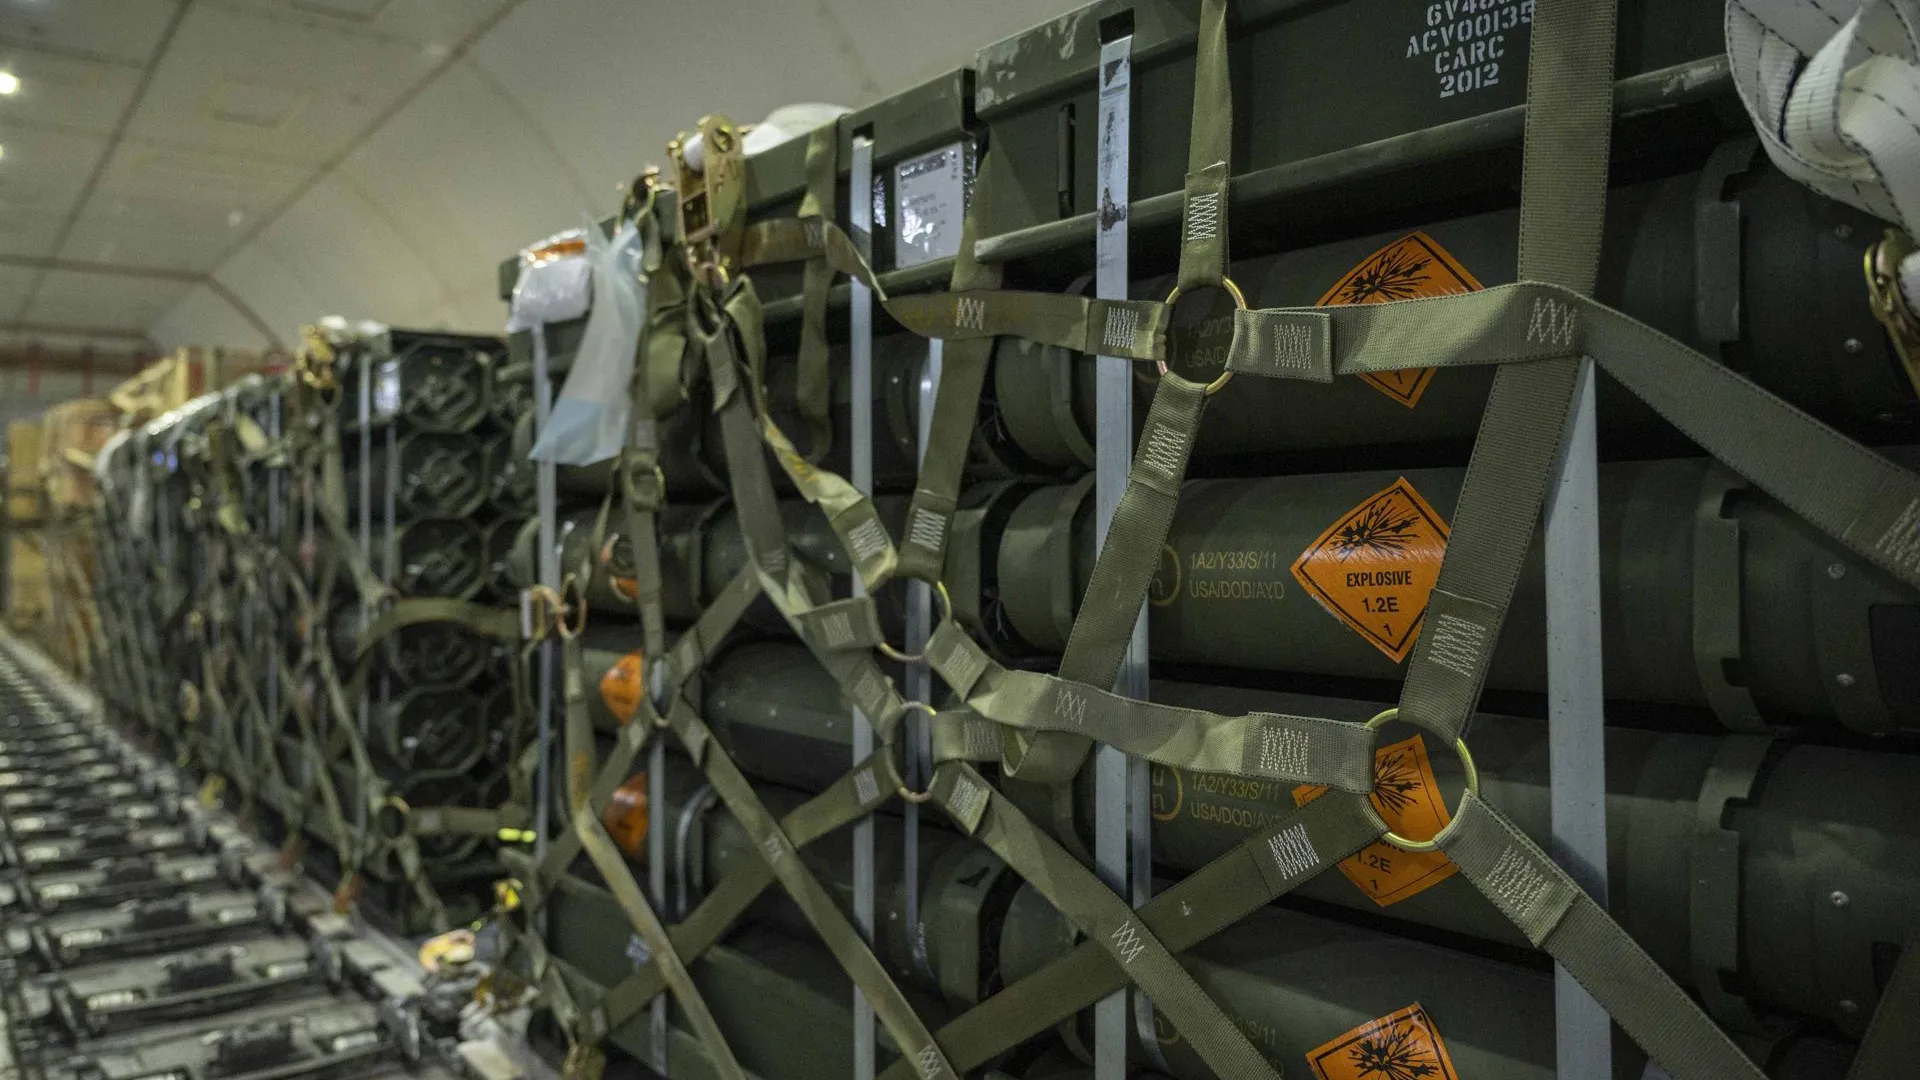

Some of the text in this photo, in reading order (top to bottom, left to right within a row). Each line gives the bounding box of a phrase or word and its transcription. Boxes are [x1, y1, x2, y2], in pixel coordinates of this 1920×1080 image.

[1434, 35, 1504, 74] CARC
[1439, 62, 1500, 99] 2012
[1346, 570, 1412, 587] EXPLOSIVE
[1361, 596, 1400, 613] 1.2E
[1382, 623, 1393, 637] 1
